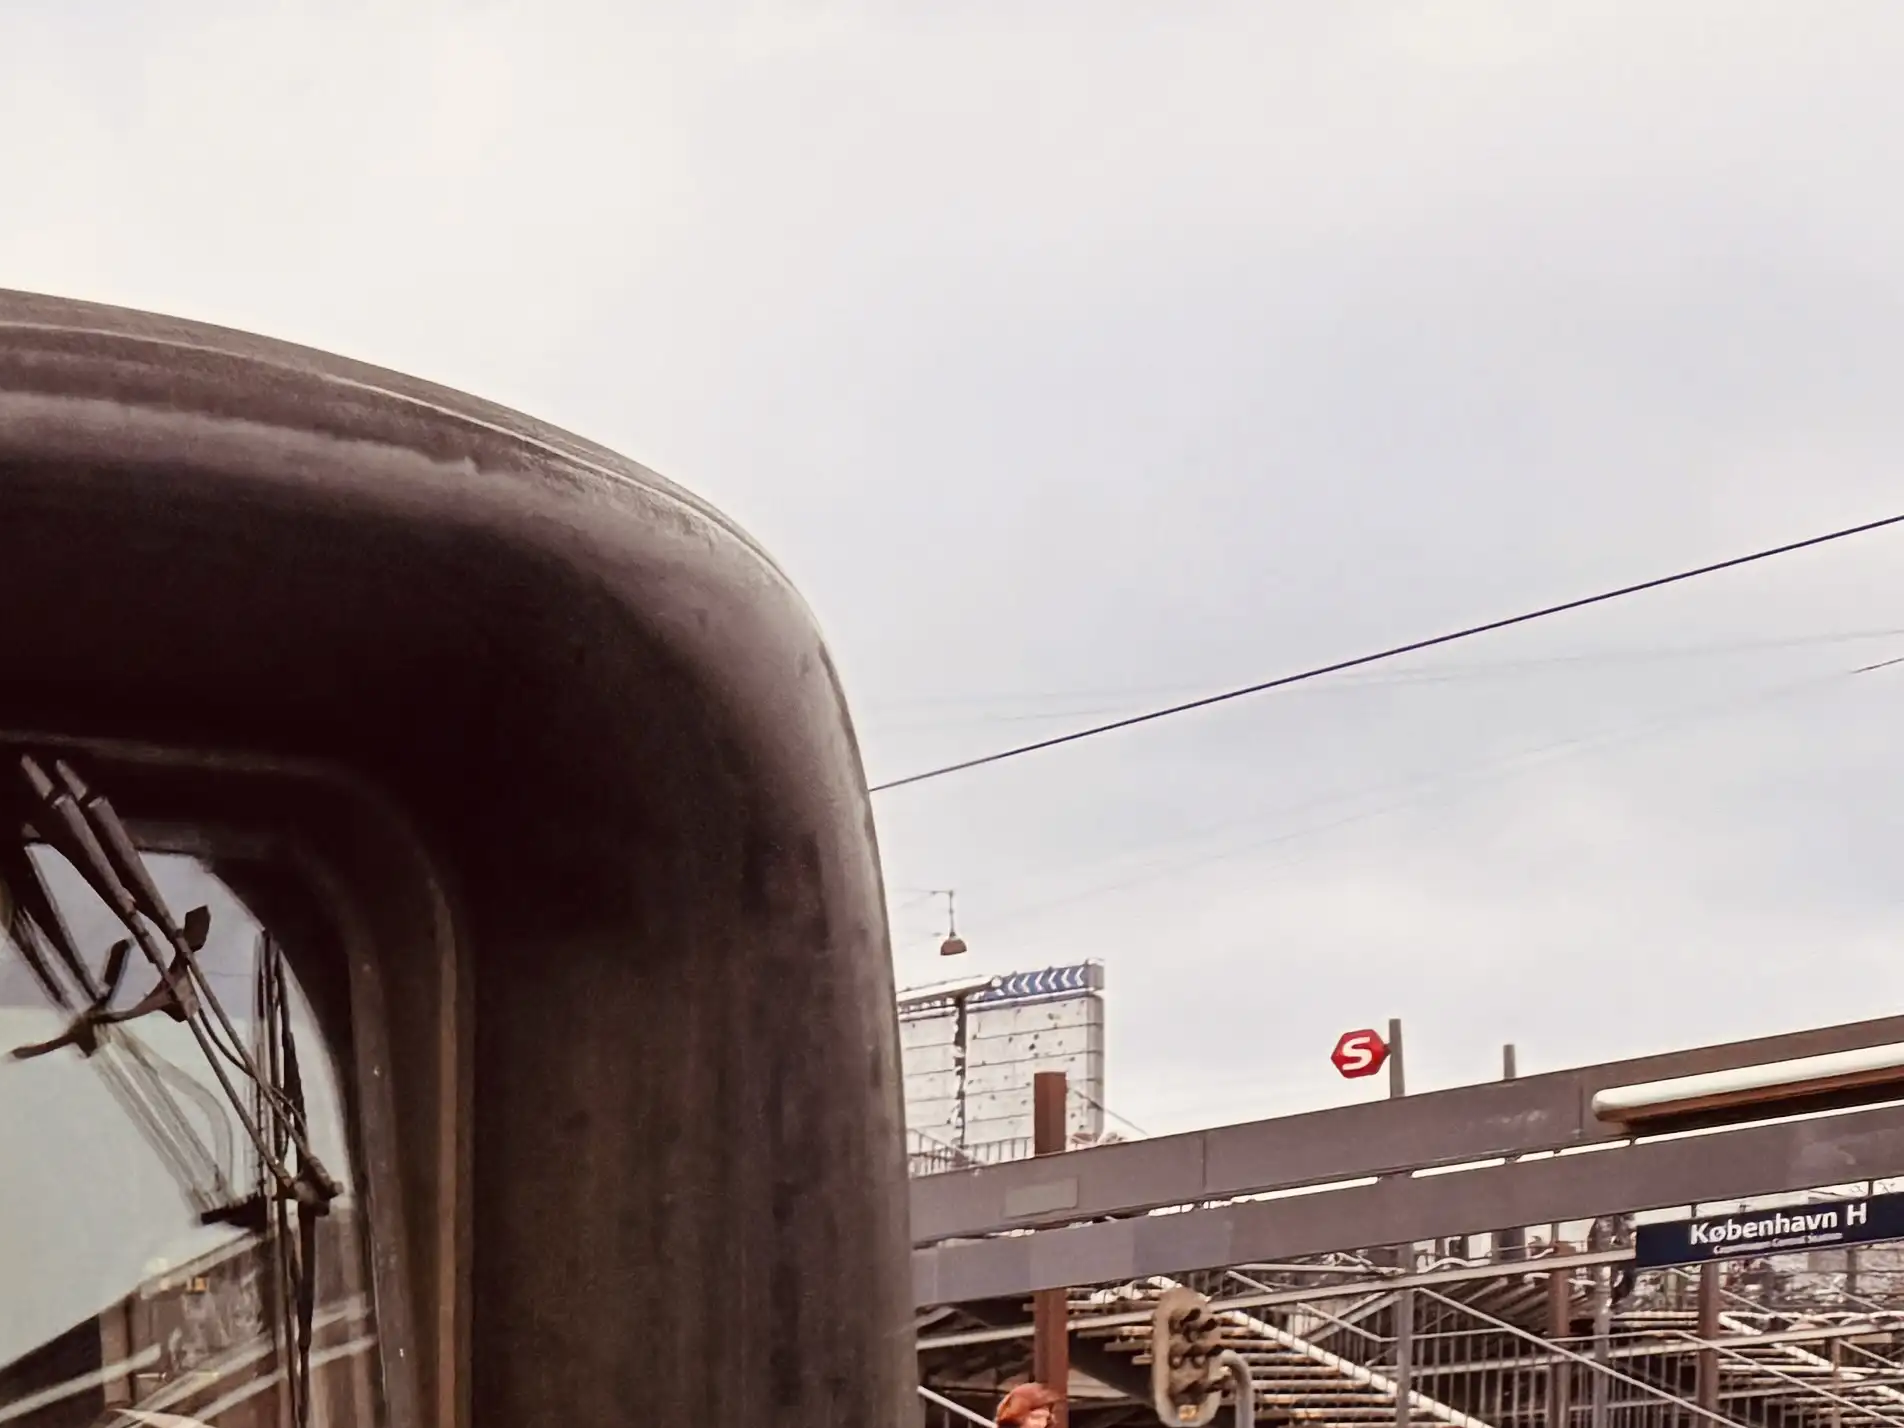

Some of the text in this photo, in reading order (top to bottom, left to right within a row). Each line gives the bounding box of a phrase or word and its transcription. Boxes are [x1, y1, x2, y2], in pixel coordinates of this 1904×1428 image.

[1342, 1036, 1372, 1070] S
[1690, 1210, 1837, 1246] København
[1846, 1202, 1868, 1226] H
